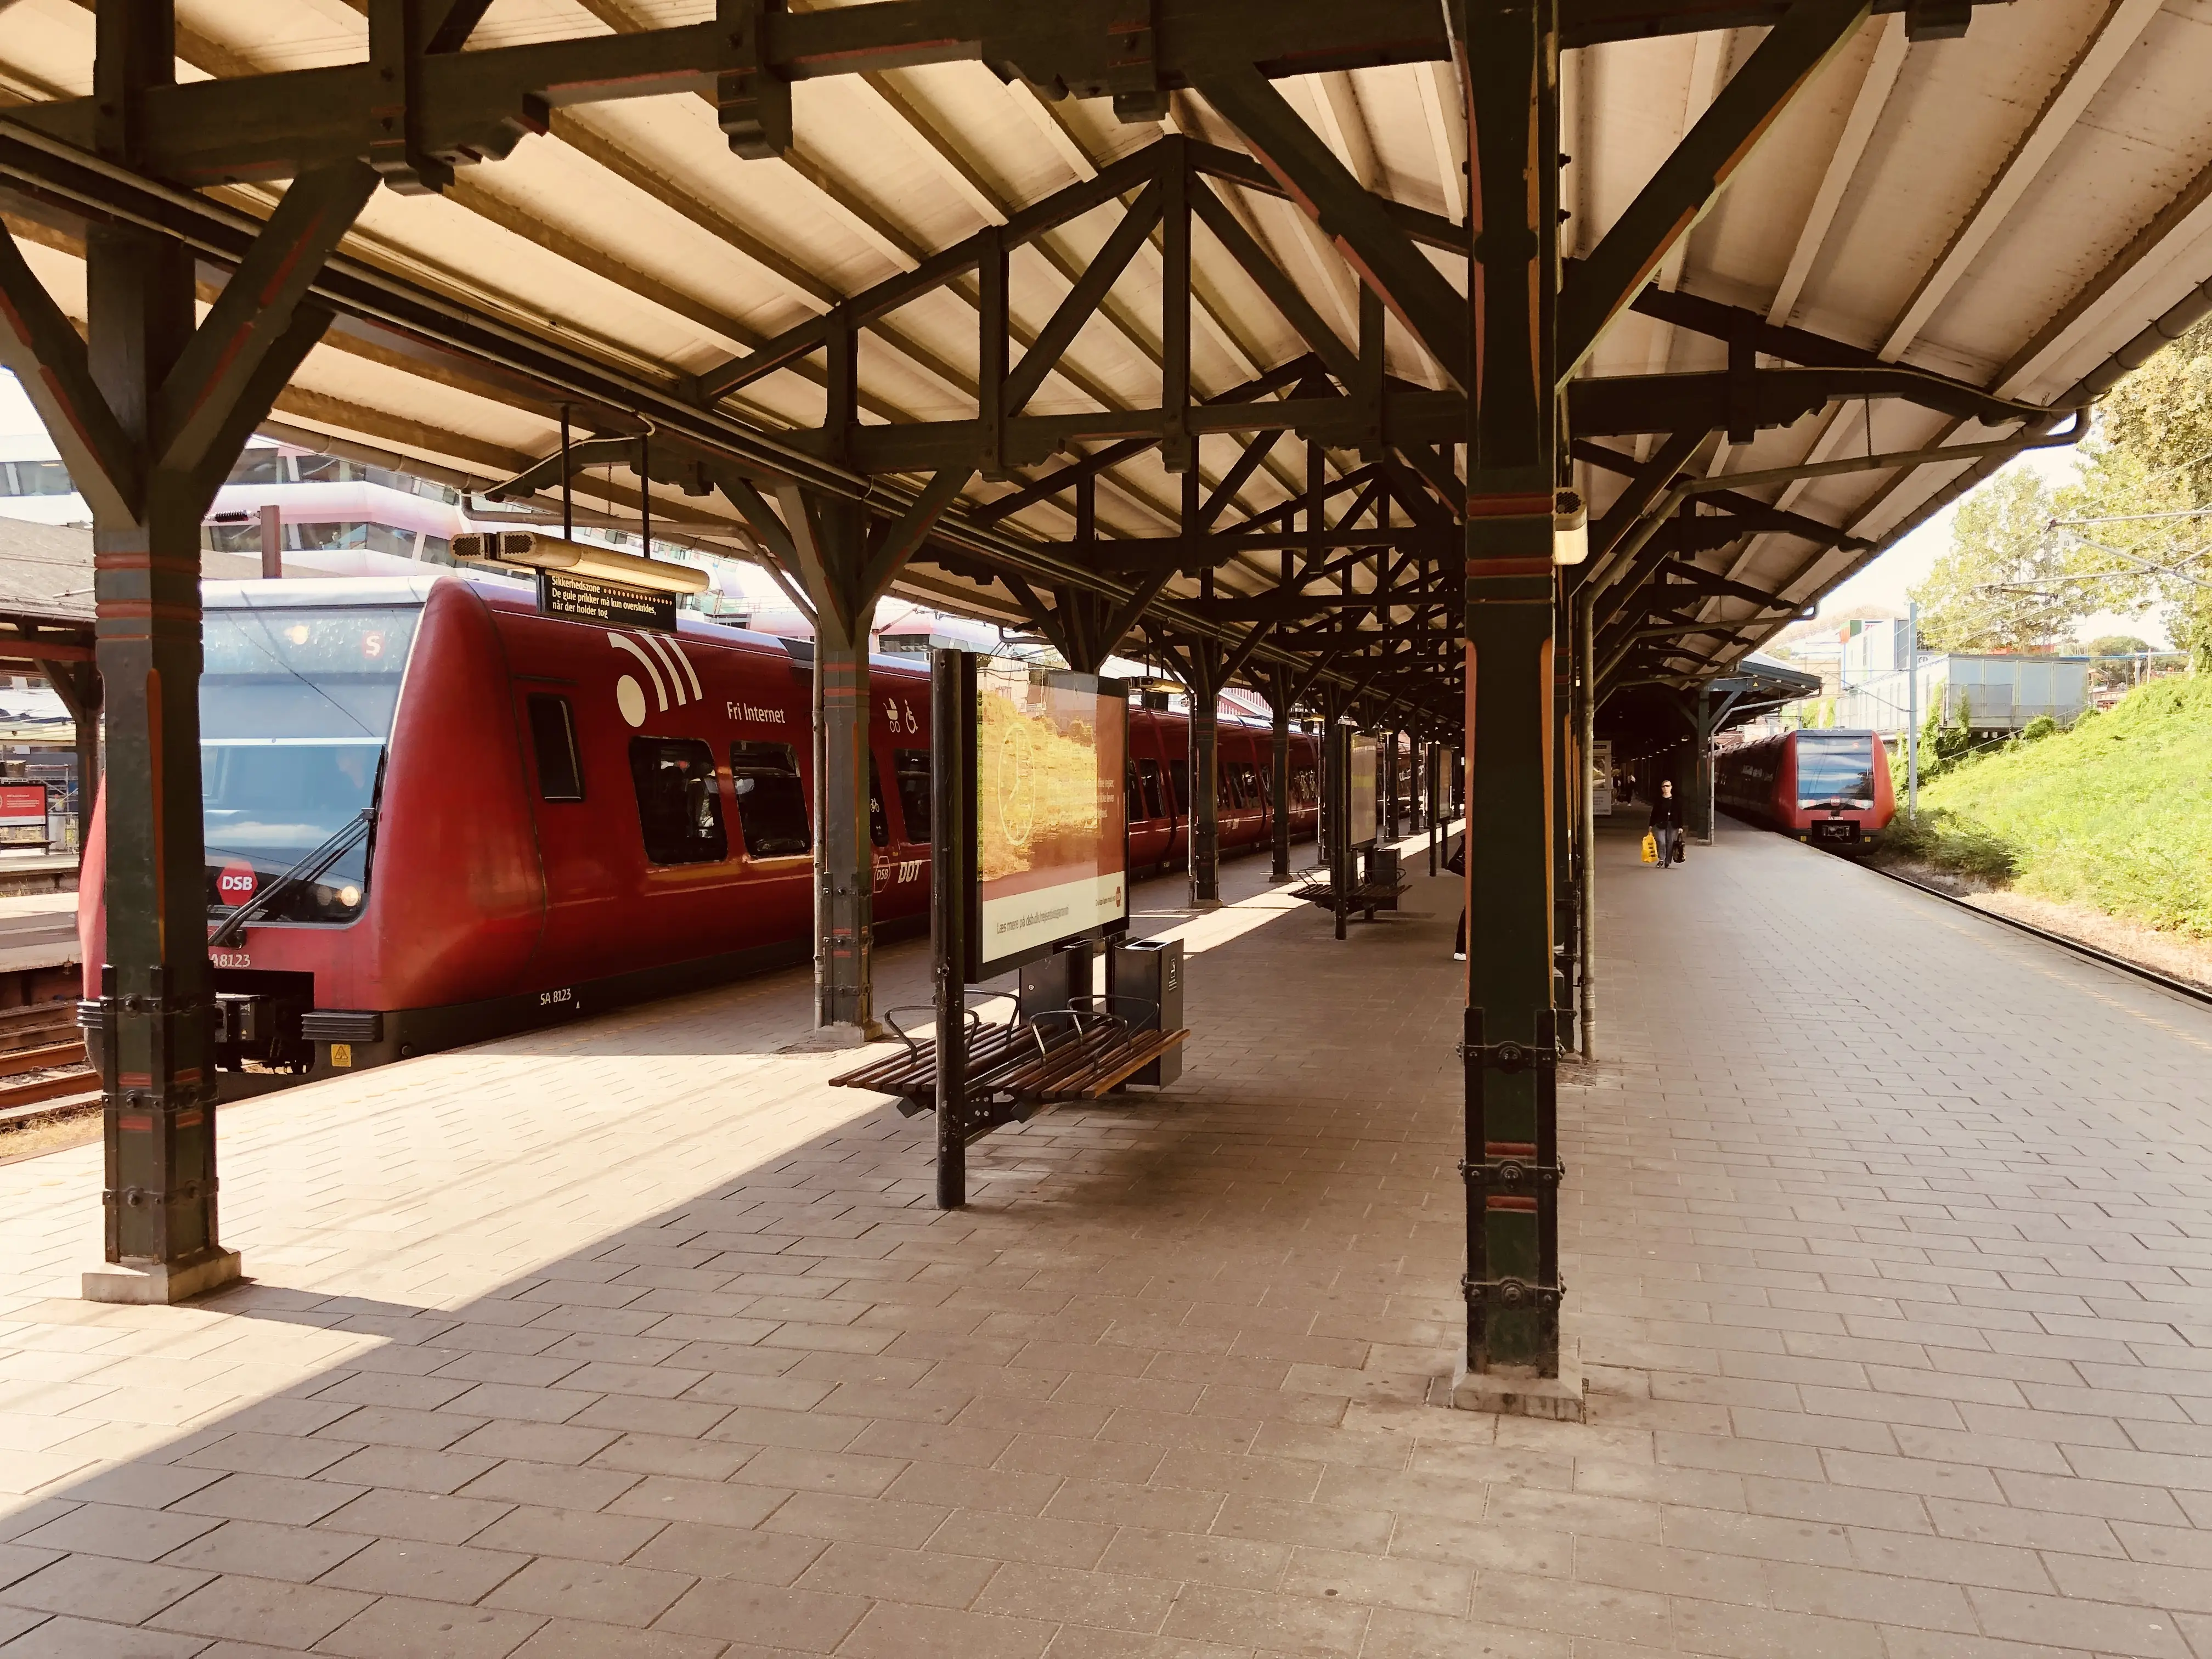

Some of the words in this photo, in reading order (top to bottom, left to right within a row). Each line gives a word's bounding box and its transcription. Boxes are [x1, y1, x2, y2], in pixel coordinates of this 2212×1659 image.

[551, 575, 601, 594] Sikkerhedszone
[552, 588, 561, 598] De
[562, 590, 576, 601] gule
[578, 593, 600, 605] prikker
[600, 596, 610, 606] må
[611, 597, 622, 609] kun
[623, 602, 657, 615] overskrides,
[552, 599, 563, 611] når
[565, 601, 575, 612] der
[577, 603, 596, 616] holder
[598, 608, 608, 619] tog
[366, 635, 381, 656] S
[727, 701, 742, 720] Fri
[743, 703, 786, 724] Internet
[876, 868, 889, 881] DSB
[898, 860, 922, 883] DOT
[222, 876, 253, 891] DSB
[997, 922, 1006, 934] Læs
[1019, 915, 1025, 930] på
[540, 992, 551, 1006] SA
[553, 988, 571, 1003] 8123
